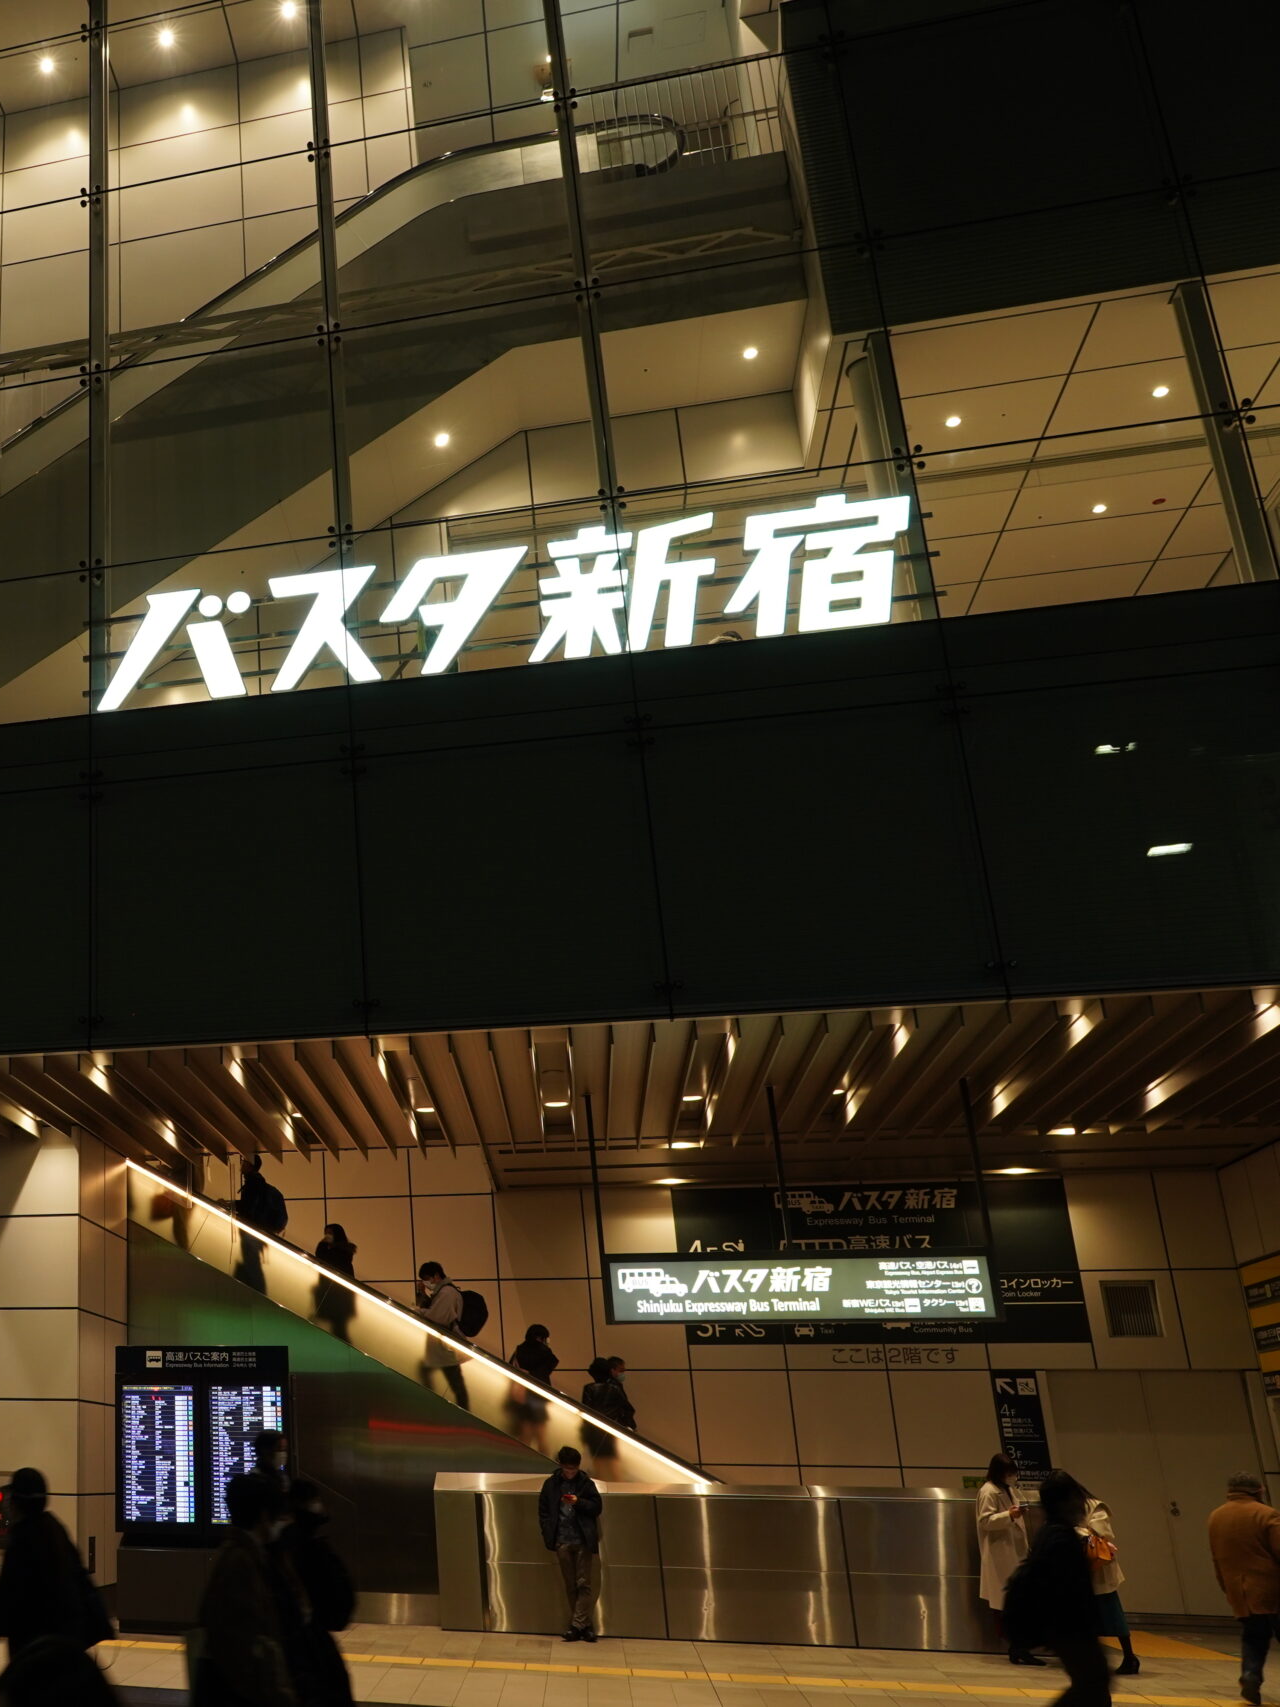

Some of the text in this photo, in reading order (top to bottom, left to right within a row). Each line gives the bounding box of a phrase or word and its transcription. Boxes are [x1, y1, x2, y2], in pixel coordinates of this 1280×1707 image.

[96, 493, 911, 713] バスタ新宿
[838, 1188, 959, 1211] バスタ新宿
[806, 1214, 936, 1227] Expressway Bus Terminal
[848, 1234, 932, 1249] 高速バス
[691, 1265, 833, 1293] バスタ新宿
[999, 1277, 1074, 1288] コインロッカー
[637, 1297, 820, 1316] Shinjuku Expressway Bus Terminal
[913, 1326, 973, 1336] Community Bus
[165, 1351, 229, 1362] 高速バスご案内
[832, 1347, 959, 1365] ここは2階です
[1000, 1403, 1016, 1417] 4F
[1006, 1445, 1024, 1459] 3F
